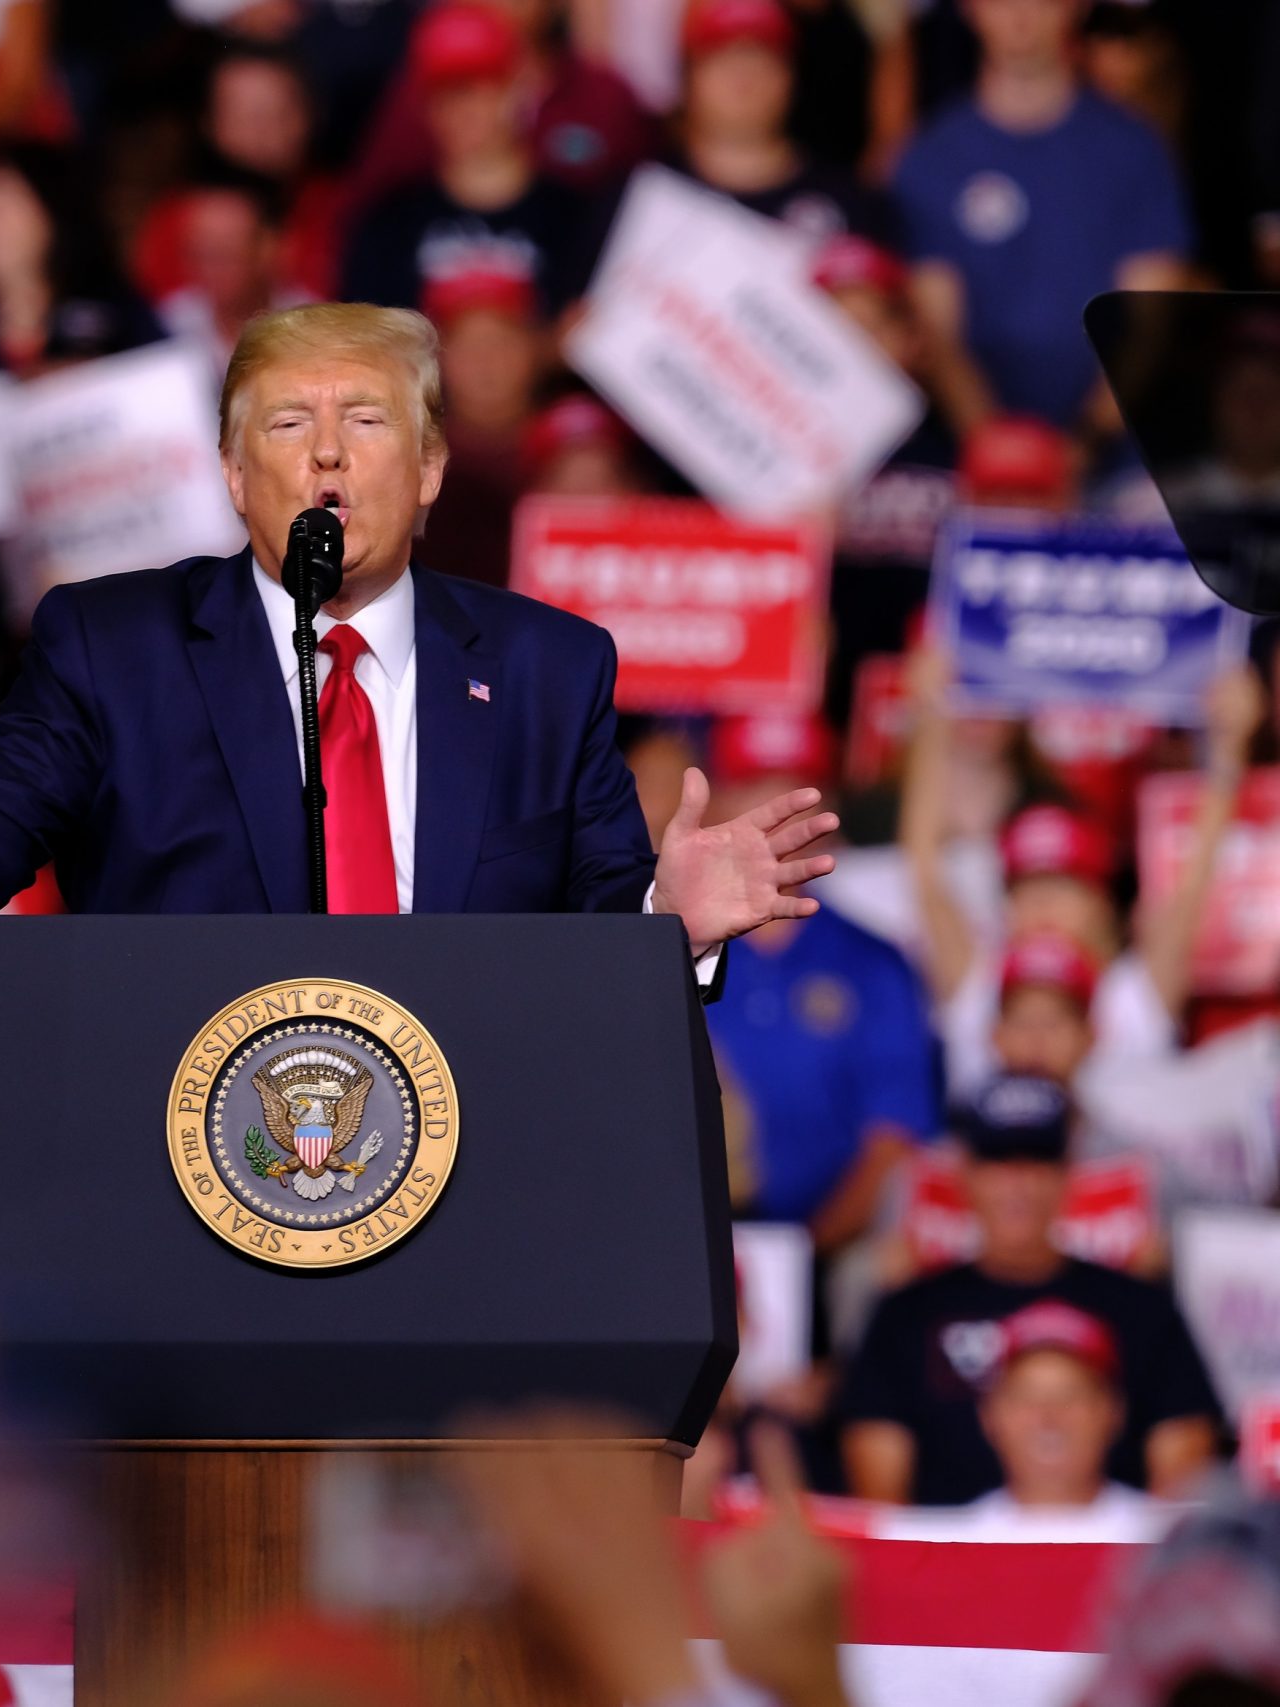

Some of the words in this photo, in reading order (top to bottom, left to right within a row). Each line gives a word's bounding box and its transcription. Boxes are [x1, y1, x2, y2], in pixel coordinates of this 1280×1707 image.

[315, 991, 343, 1010] OF
[349, 997, 384, 1025] THE
[178, 988, 307, 1116] PRESIDENT
[389, 1021, 449, 1140] UNITED
[181, 1126, 203, 1167] THE
[193, 1171, 214, 1196] OF
[213, 1194, 286, 1254] SEAL
[338, 1166, 437, 1254] STATES
